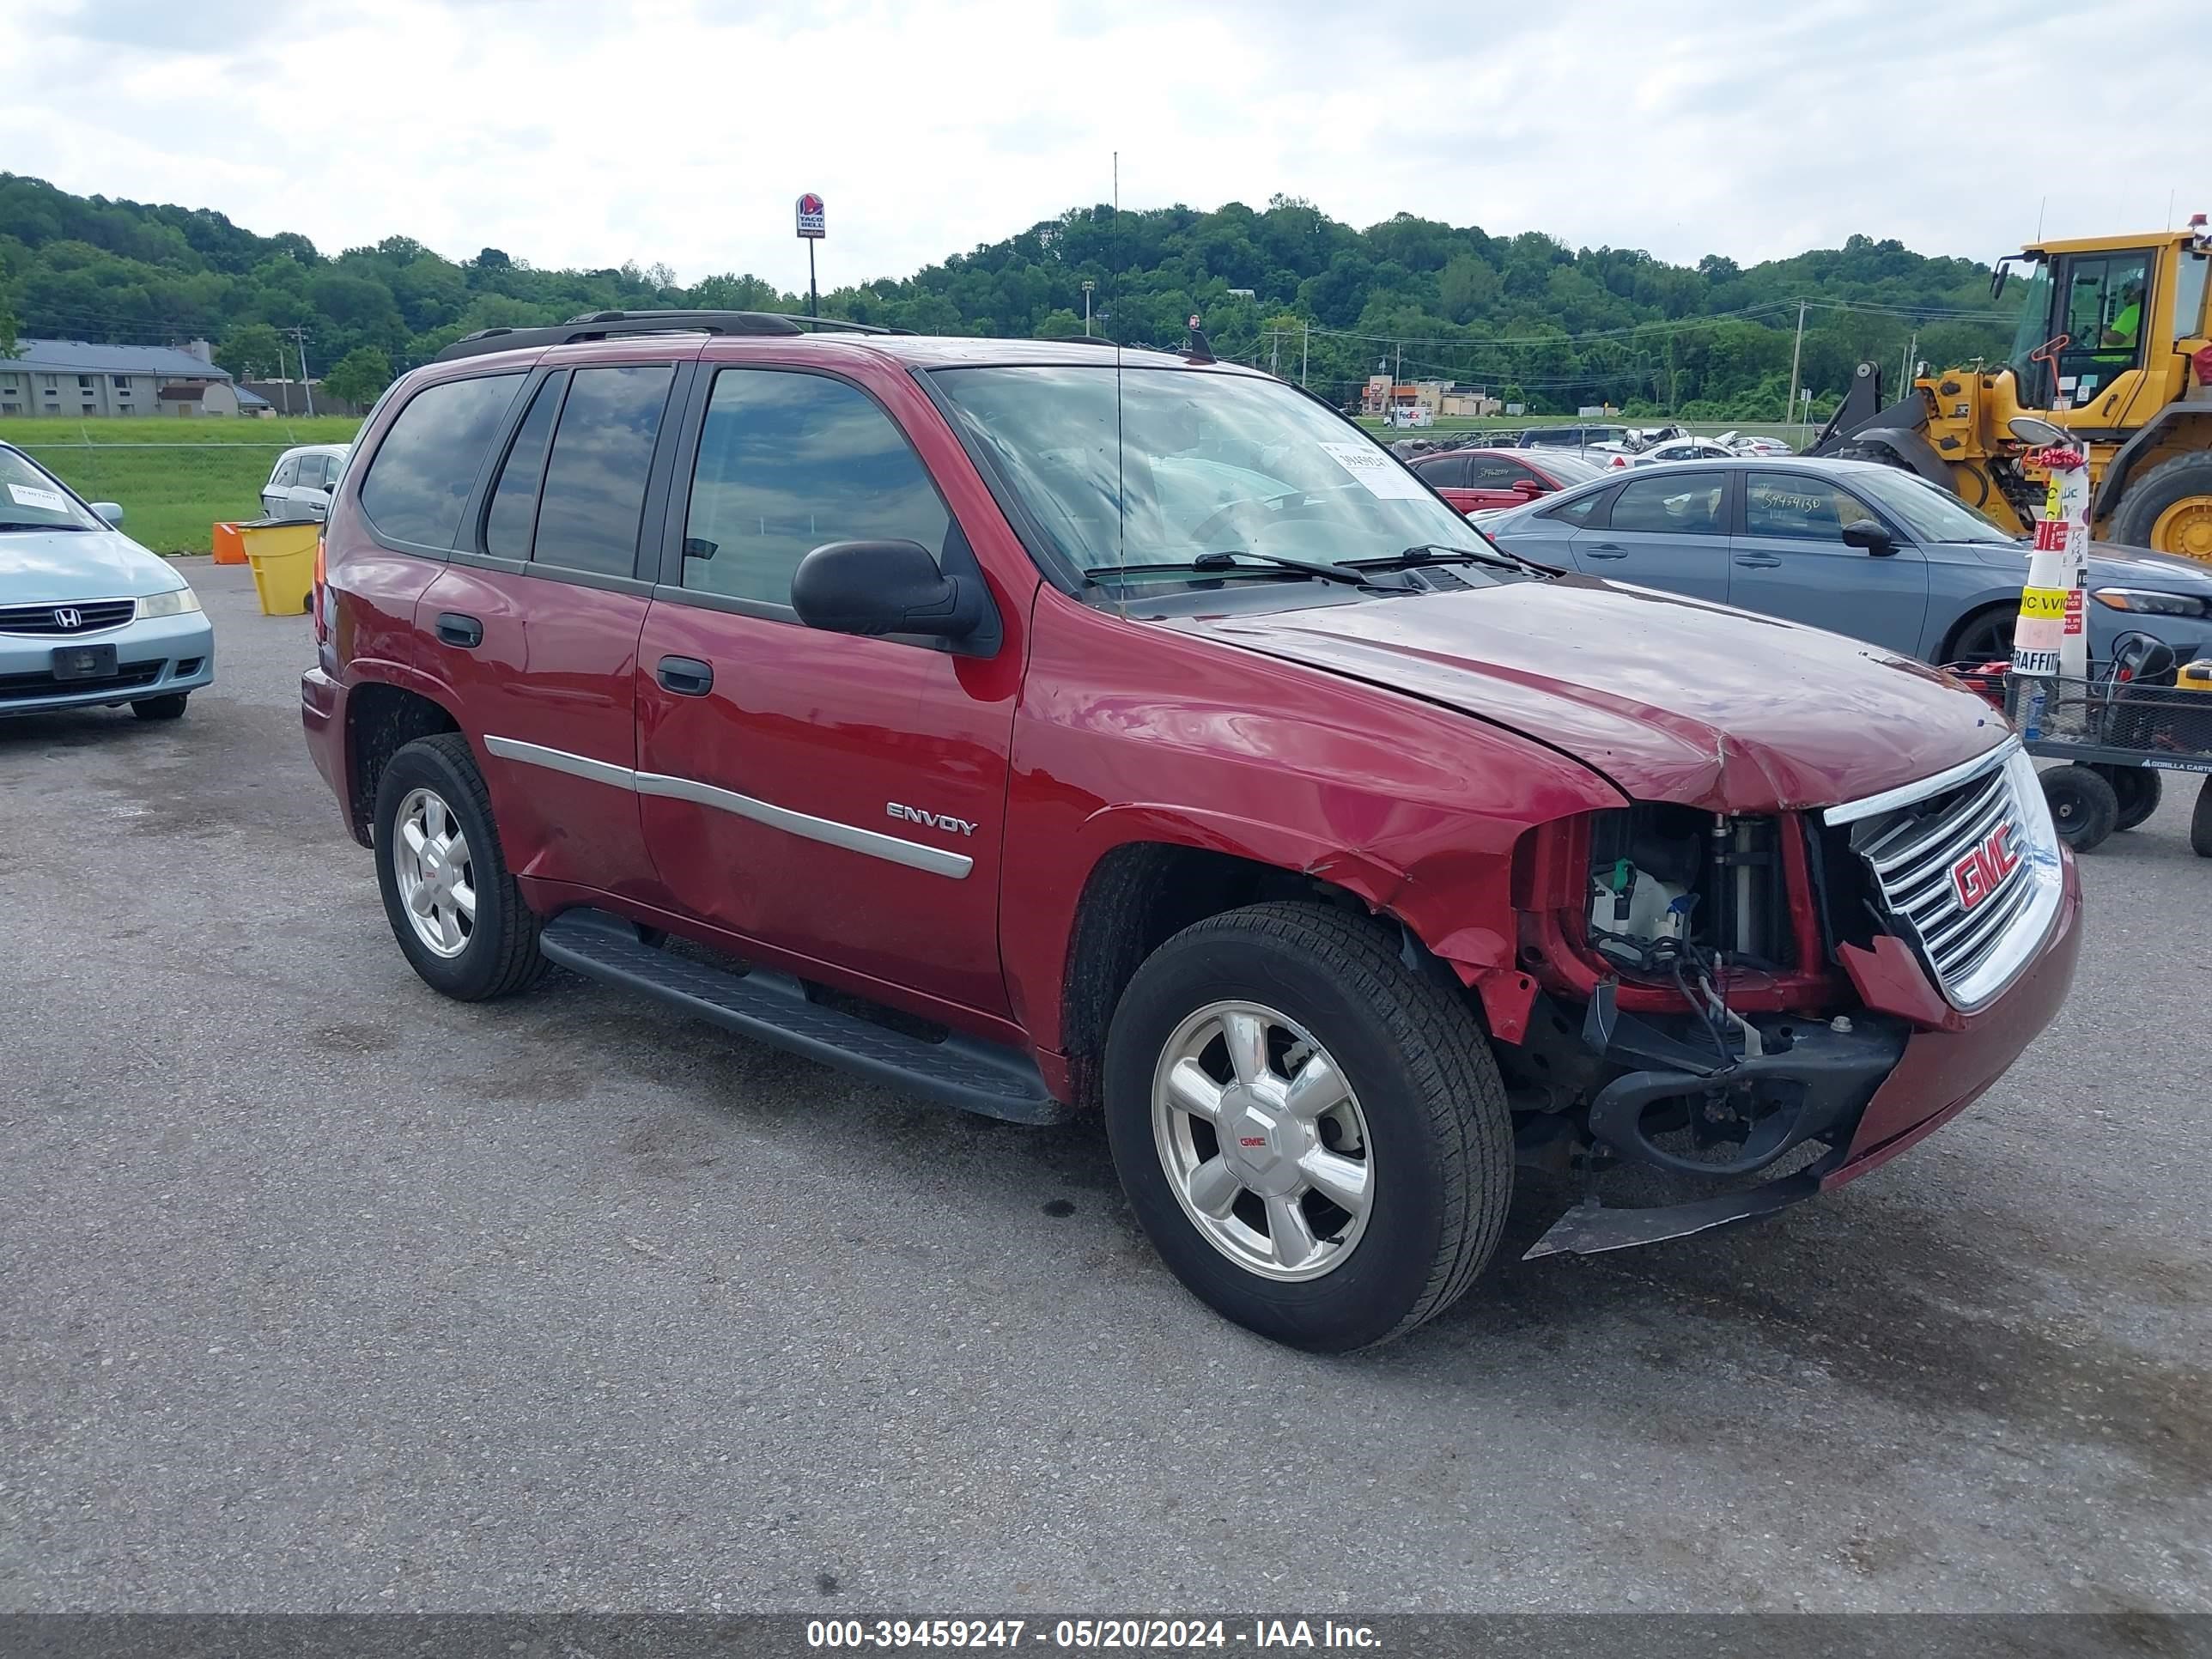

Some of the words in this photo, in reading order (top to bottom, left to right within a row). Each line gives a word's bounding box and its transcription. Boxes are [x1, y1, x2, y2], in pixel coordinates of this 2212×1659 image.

[1399, 410, 1420, 419] FedEx
[2151, 761, 2185, 769] GORILLA
[886, 801, 979, 836] ENVOY
[1951, 821, 2019, 911] GMC
[1239, 1136, 1267, 1147] GMC
